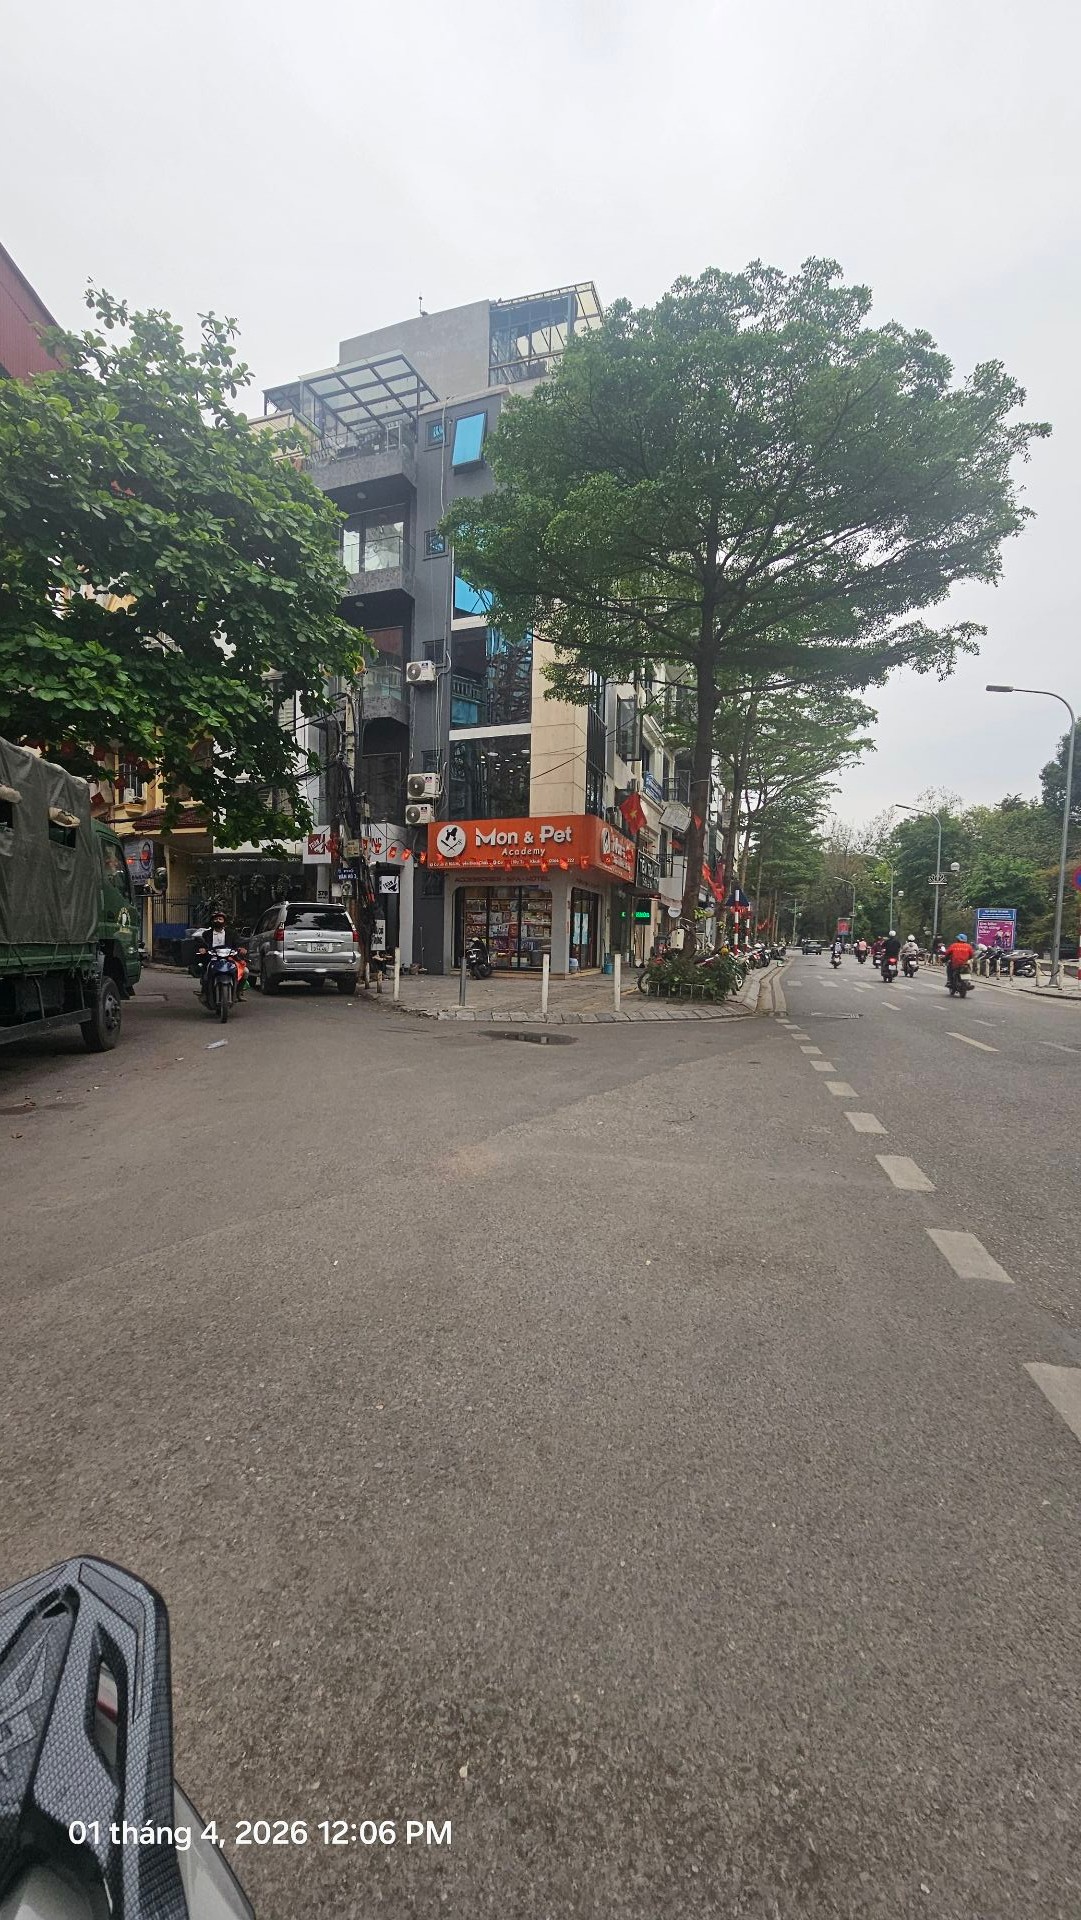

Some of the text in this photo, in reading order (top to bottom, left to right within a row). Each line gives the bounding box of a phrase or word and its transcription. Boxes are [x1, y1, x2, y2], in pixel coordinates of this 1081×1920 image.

[475, 825, 572, 846] Mon & Pet
[501, 846, 546, 857] Academy
